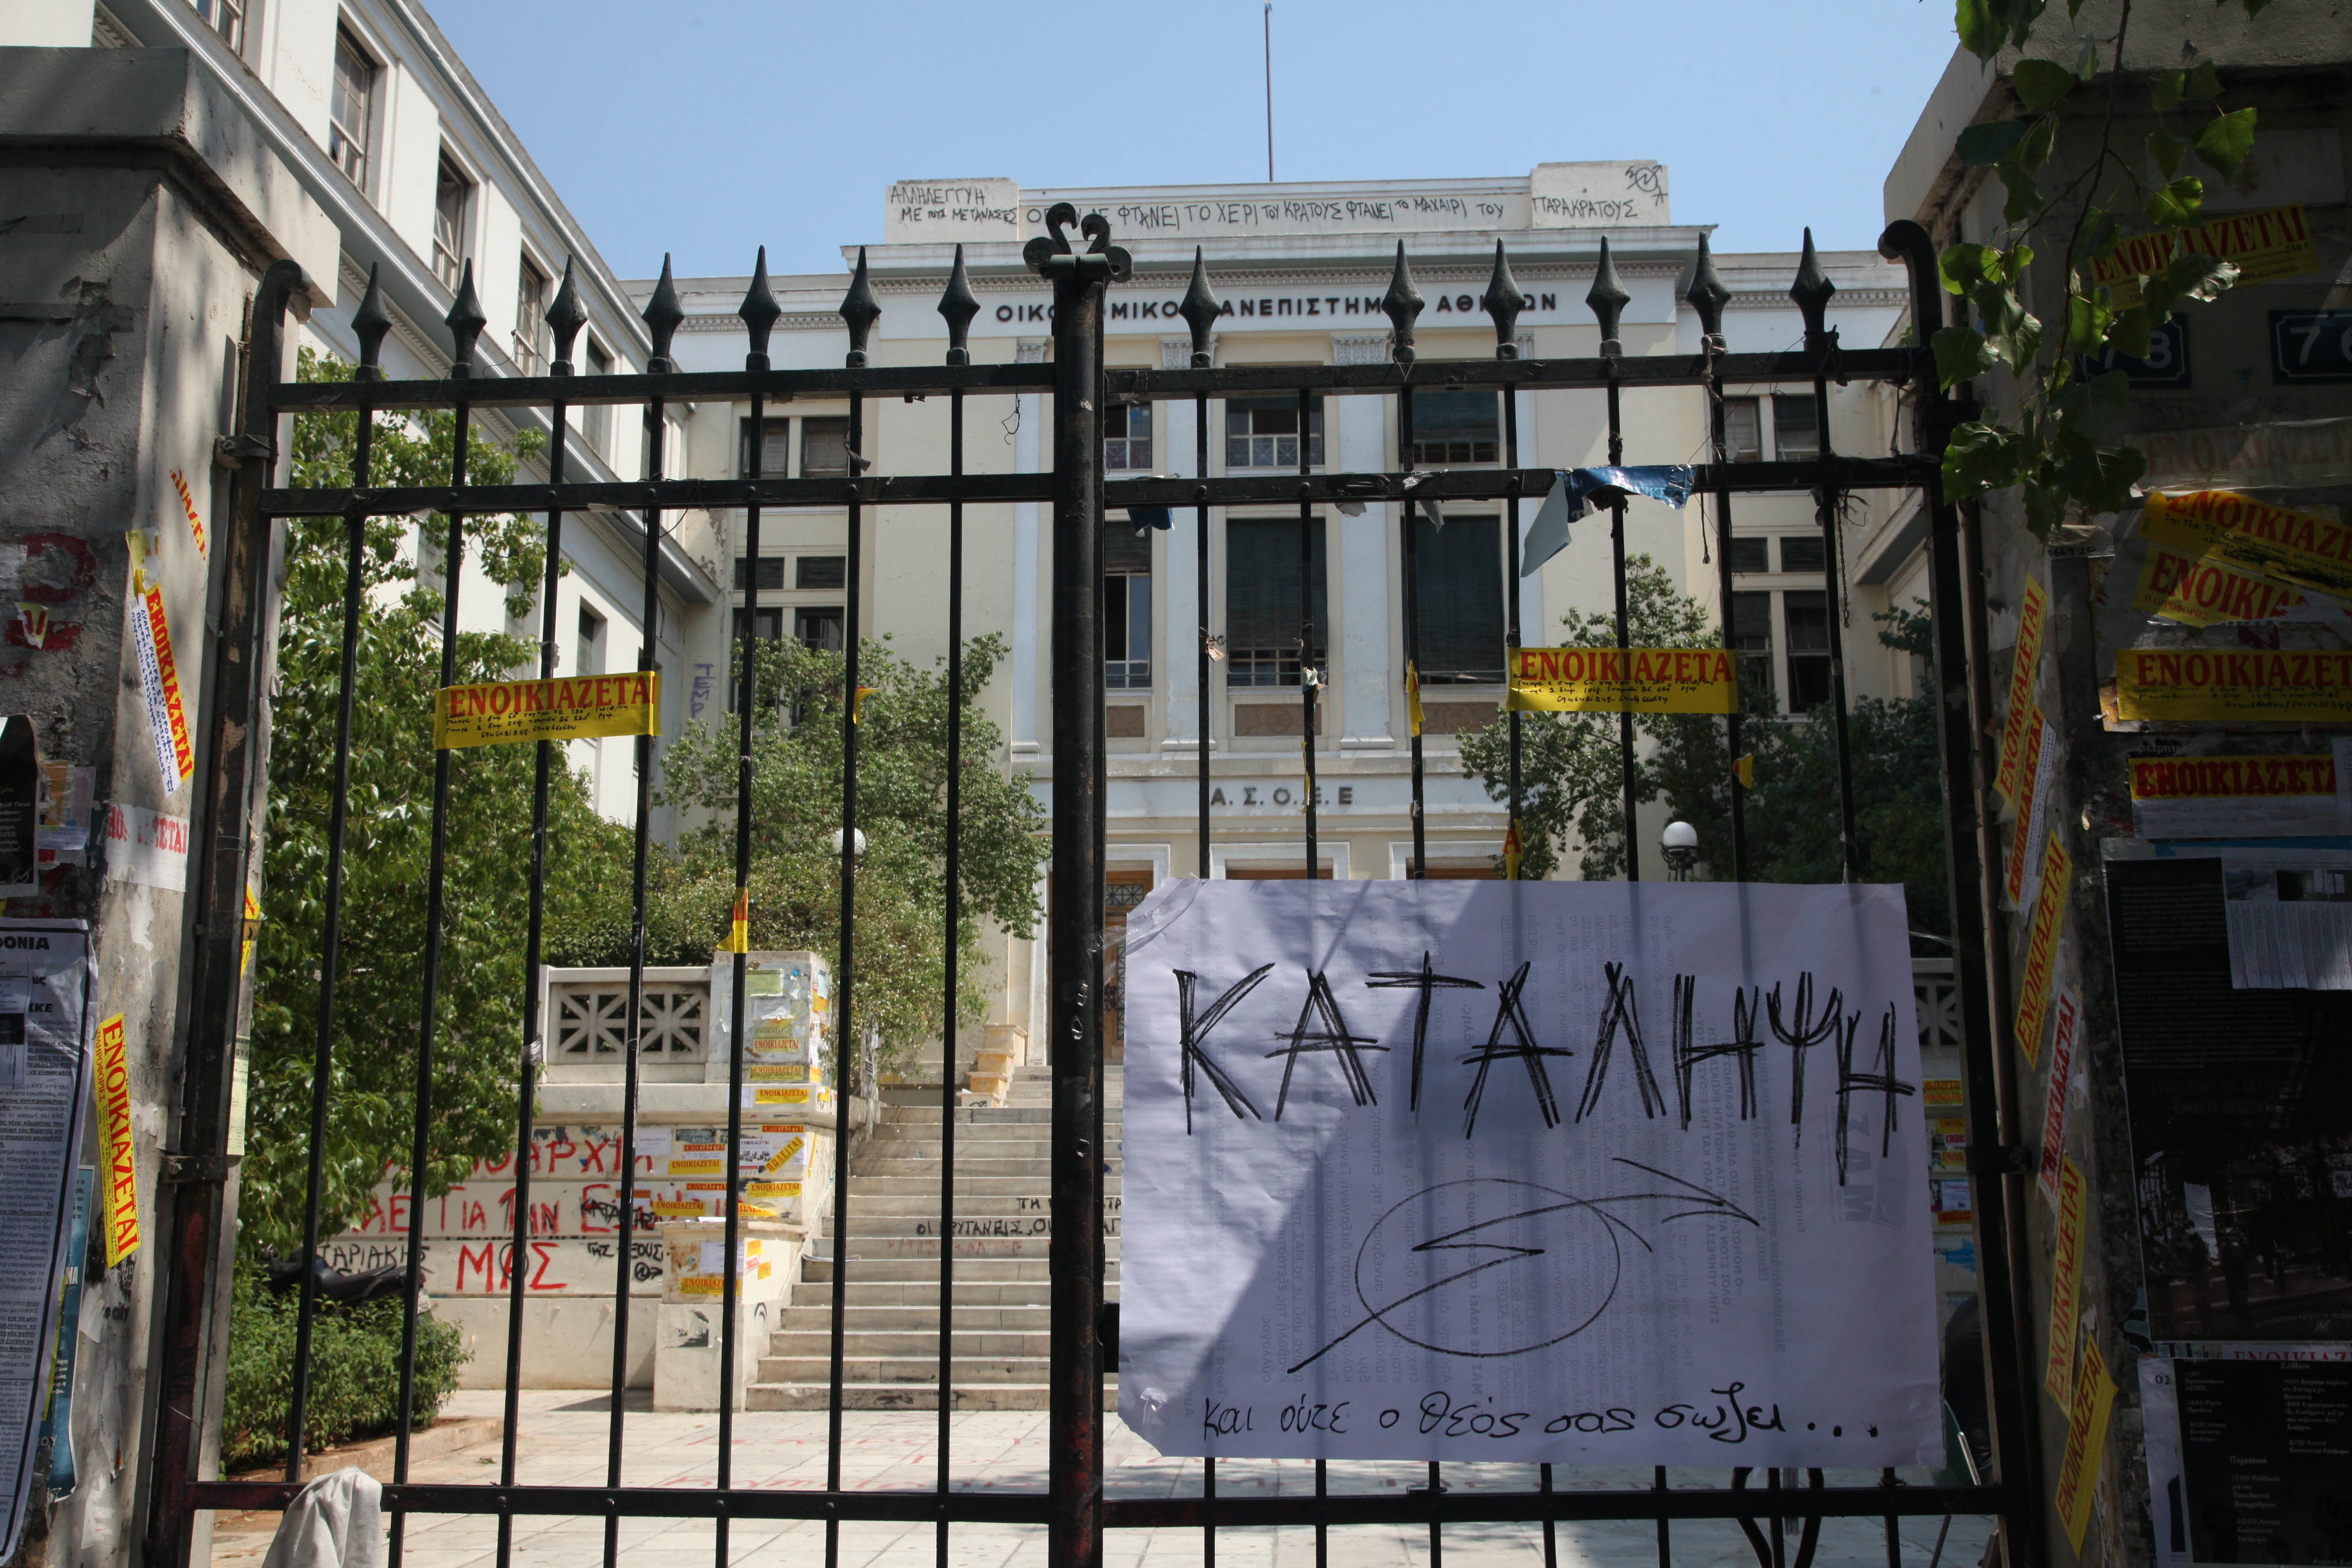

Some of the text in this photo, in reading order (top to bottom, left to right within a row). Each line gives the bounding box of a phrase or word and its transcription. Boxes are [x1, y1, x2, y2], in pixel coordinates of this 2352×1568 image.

[902, 208, 922, 222] ΜΕ
[1118, 205, 1180, 231] ΦΤΑΝΕΙ
[1188, 204, 1211, 221] ΤΟ
[1218, 202, 1259, 227] ΧΕΡΙ
[1265, 203, 1280, 219] ΤΟΥ
[1284, 200, 1343, 222] ΚΡΑΤΟΥΣ
[1346, 200, 1393, 222] ΦΤΑΝΕΙ
[1413, 198, 1468, 218] ΜΑΧΑΙΡΙ
[1476, 202, 1503, 218] ΤΟΥ
[1532, 196, 1638, 218] ΠΑΡΑΚΡΑΤΟΥΣ
[448, 675, 655, 717] ΕΝΟΙΚΙΑΖΕΤΑΙ
[2016, 840, 2066, 1053] ΕΝΟΙΚΙΑΖΕΤΑΙ
[1173, 951, 1915, 1186] ΚΑΤΑΛΗΨΗ
[102, 1019, 138, 1254] ΕΝΟΙΚΙΑΖΕΤΑΙ
[672, 1160, 720, 1169] ΕΝΟΙΚΙΑΖΕΤΑΙ
[656, 1202, 704, 1210] ΕΝΟΙΚΙΑΖΕΤΑΙ
[751, 1183, 800, 1192] ΕΝΟΙΚΙΑΖΕΤΑΙ
[2047, 1162, 2079, 1399] ΕΝΟΙΚΙΑΖΕΤΑΙ
[1204, 1391, 1635, 1440] και ούτε ο θεός σας
[2057, 1344, 2104, 1526] ΕΝΟΙΚΙΑΖΕΤΑΙ
